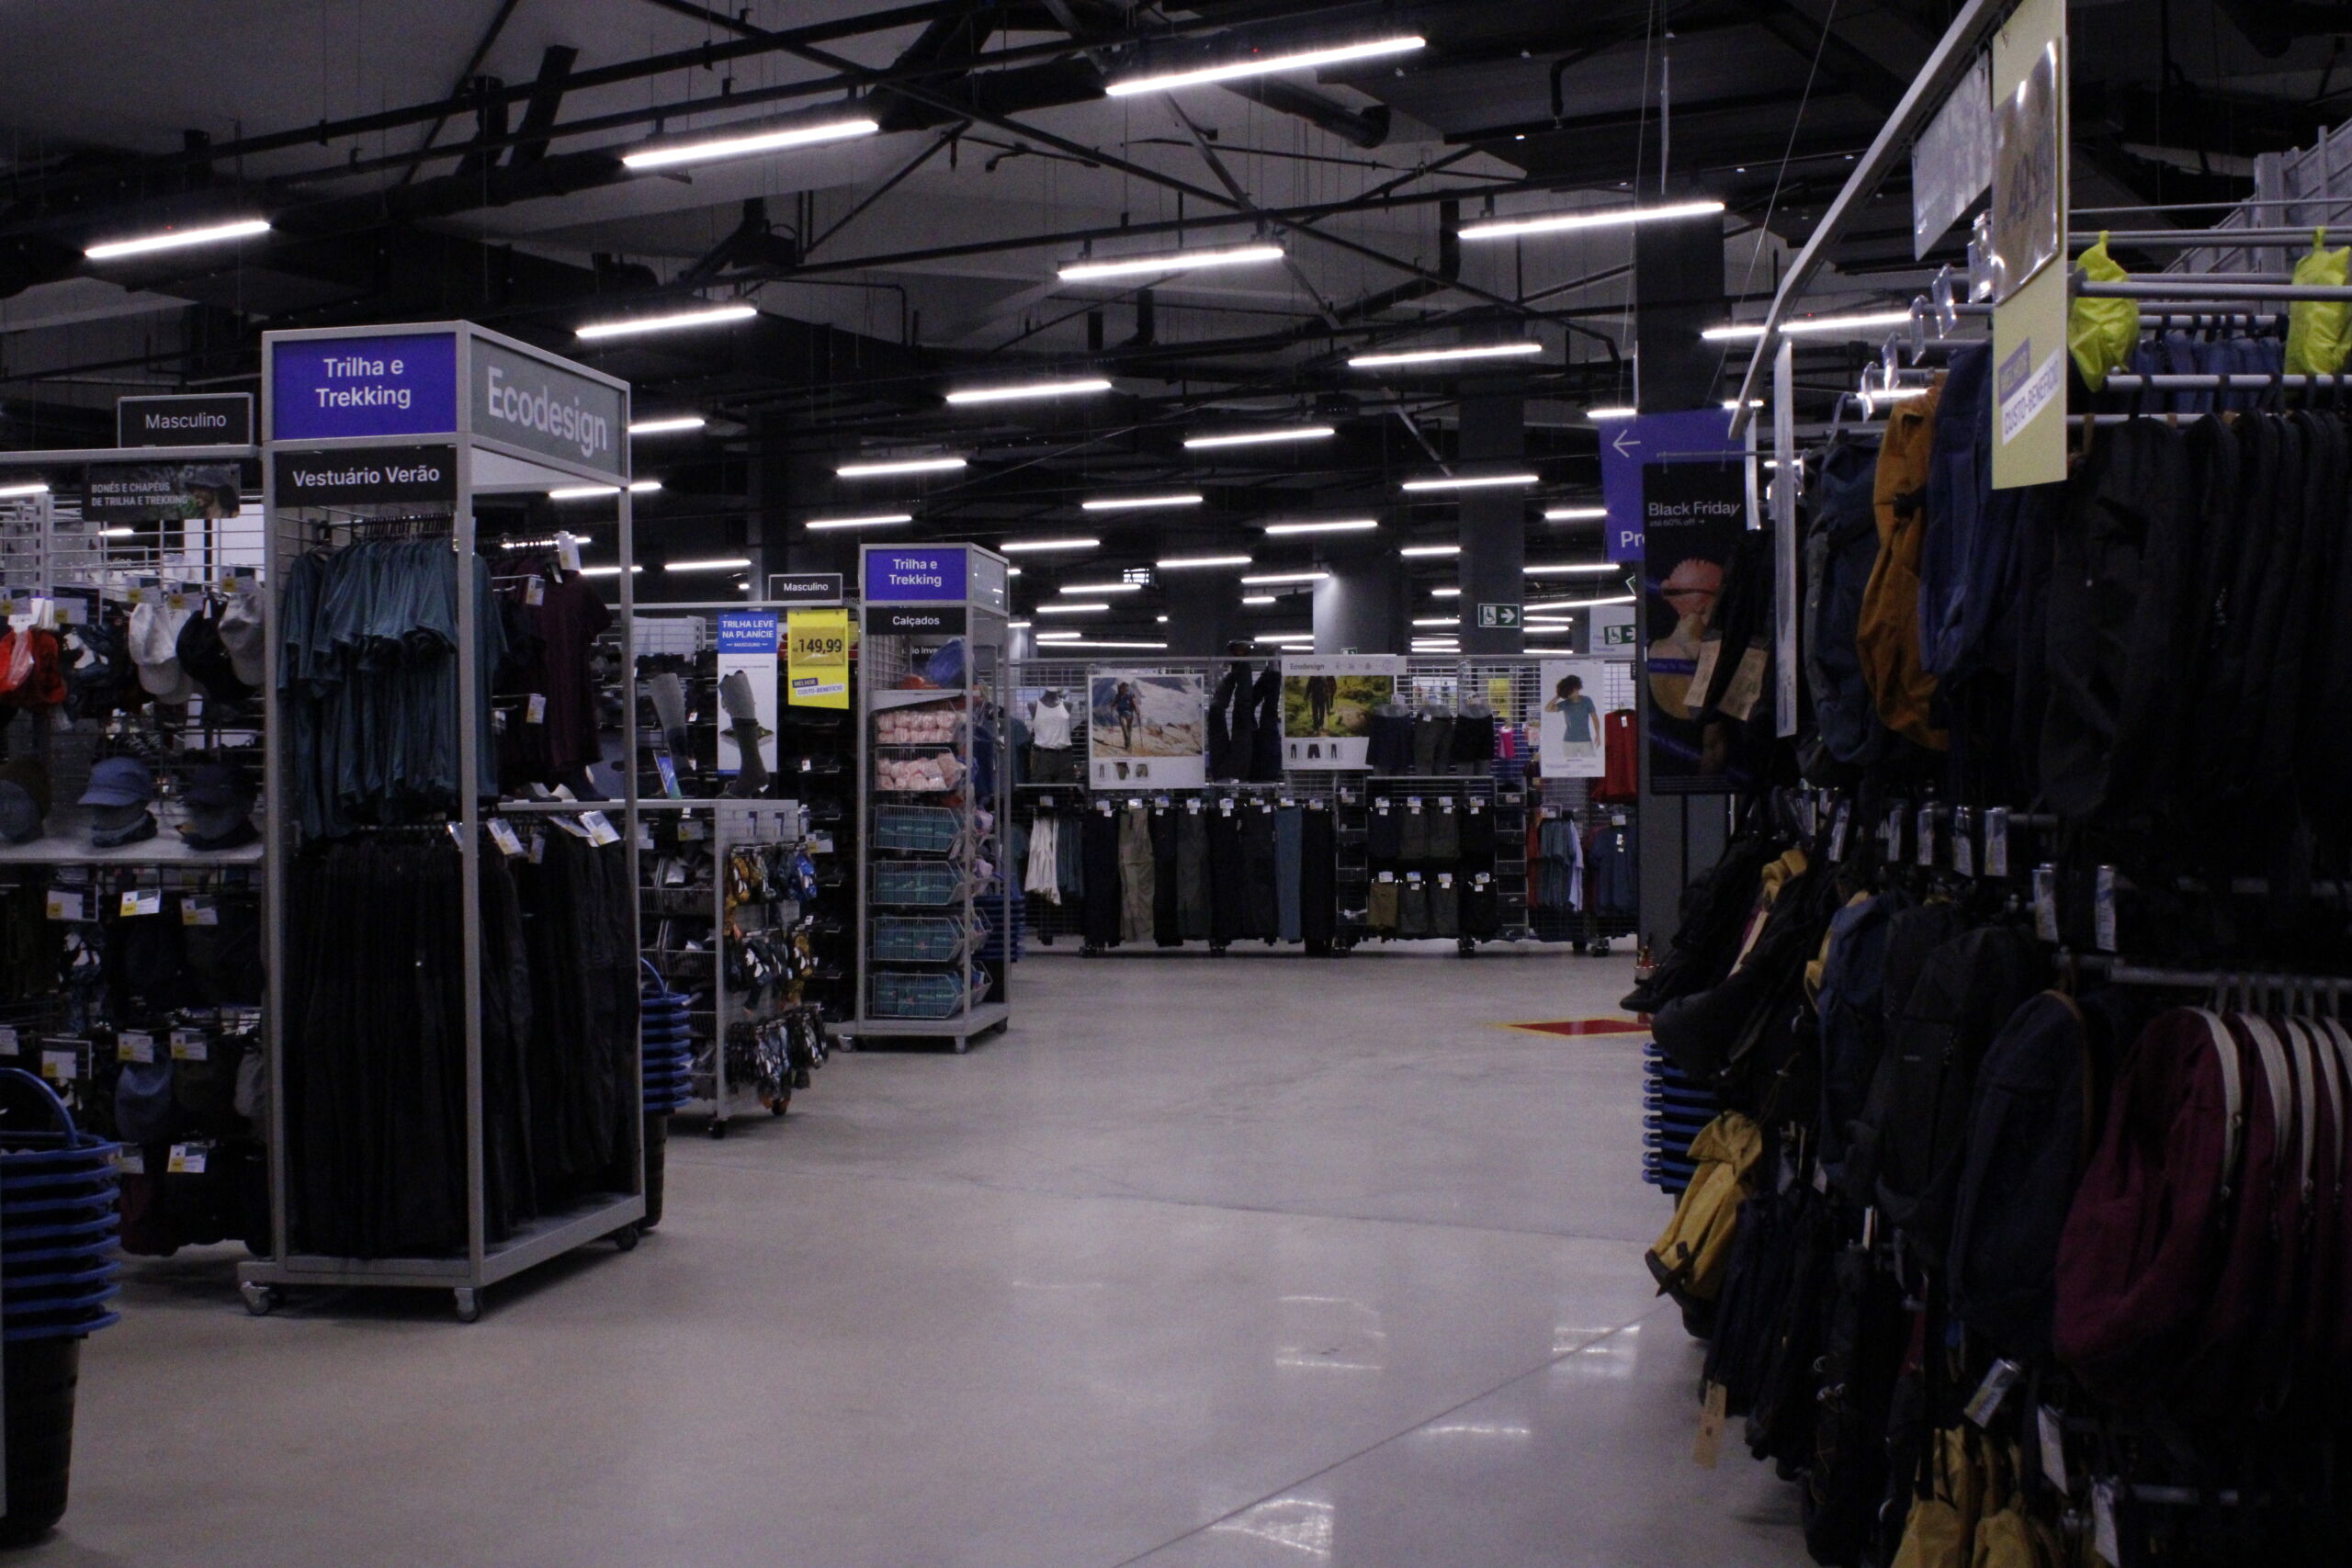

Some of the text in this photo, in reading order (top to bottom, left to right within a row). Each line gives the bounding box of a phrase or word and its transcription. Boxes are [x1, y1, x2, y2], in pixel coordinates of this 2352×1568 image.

[323, 356, 404, 378] Trilha e
[315, 385, 412, 410] Trekking
[488, 366, 607, 457] Ecodesign
[145, 412, 227, 429] Masculino
[292, 464, 441, 487] Vestuário Verão
[92, 481, 171, 493] BONÉS E CHAPÉUS
[92, 494, 188, 506] DE TRILHA E TREKKING
[1648, 501, 1741, 517] Black Friday
[892, 558, 938, 570] Trilha e
[784, 582, 829, 592] Masculino
[888, 574, 942, 587] Trekking
[722, 620, 774, 628] TRILHA LEVE
[892, 615, 940, 627] Calçados
[722, 629, 774, 638] NA PLANÍCIE
[799, 638, 842, 654] 149,99
